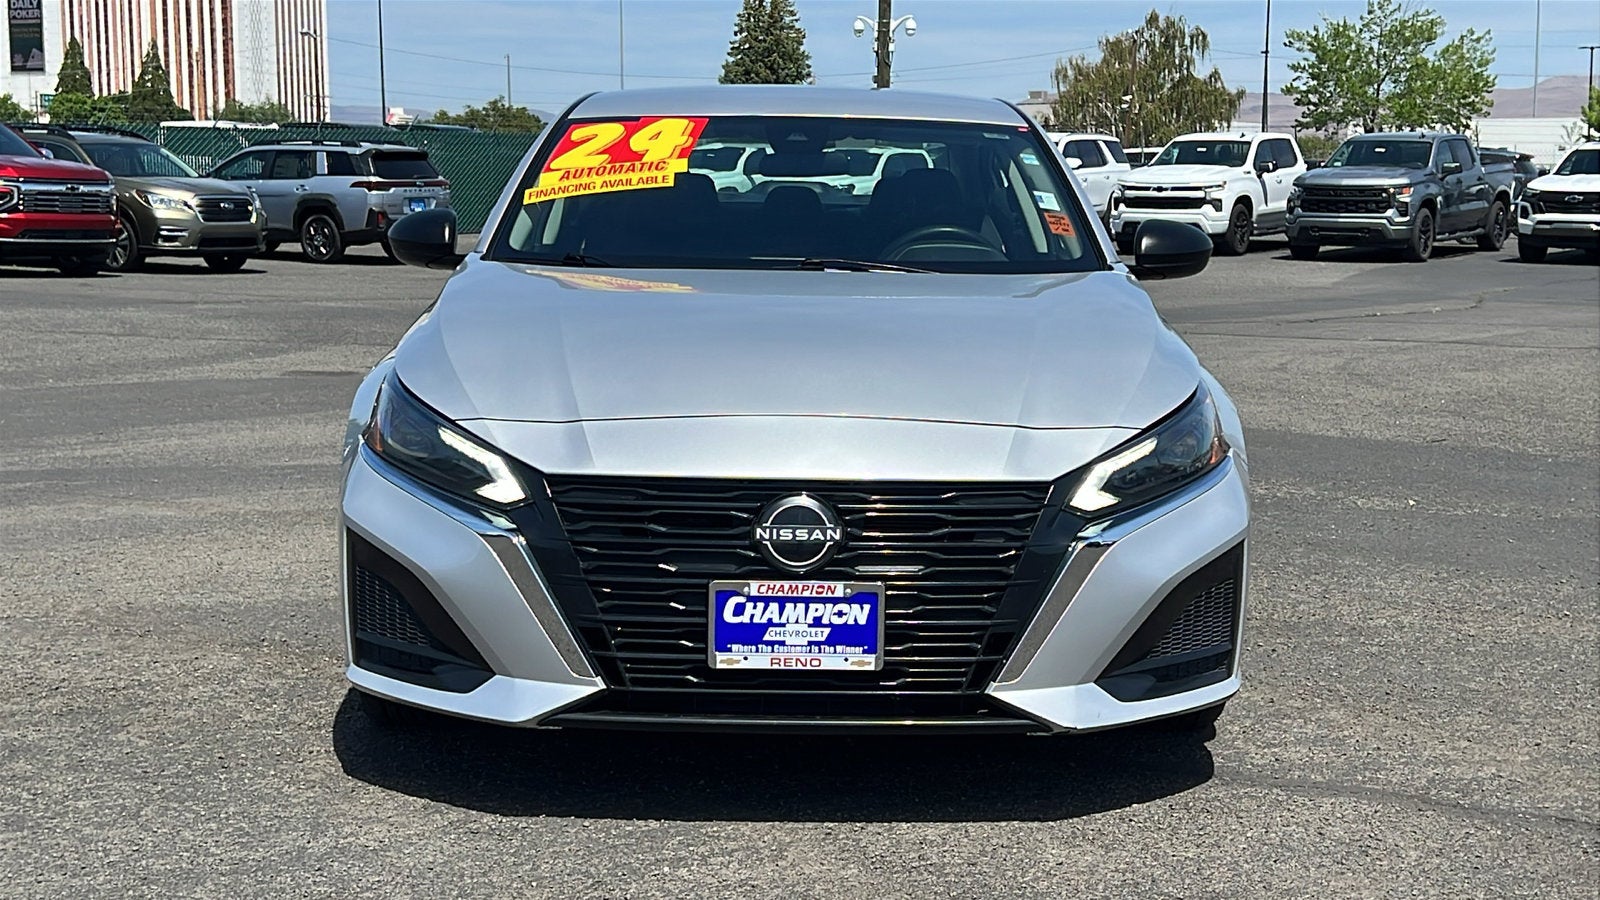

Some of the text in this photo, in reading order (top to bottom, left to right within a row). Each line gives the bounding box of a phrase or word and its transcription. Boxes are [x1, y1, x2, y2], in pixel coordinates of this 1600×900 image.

[11, 0, 38, 9] DAILY
[10, 9, 40, 19] POKER
[549, 117, 694, 172] 24
[558, 160, 667, 181] AUTOMATIC
[528, 175, 670, 200] FINANCING AVAILABLE
[756, 528, 840, 541] NISSAN
[757, 584, 837, 595] CHAMPION
[723, 596, 871, 625] CHAMPION
[768, 629, 825, 639] CHEVROLET
[758, 644, 772, 653] The
[774, 644, 811, 654] Customer
[820, 645, 834, 654] The
[770, 657, 822, 667] RENO
